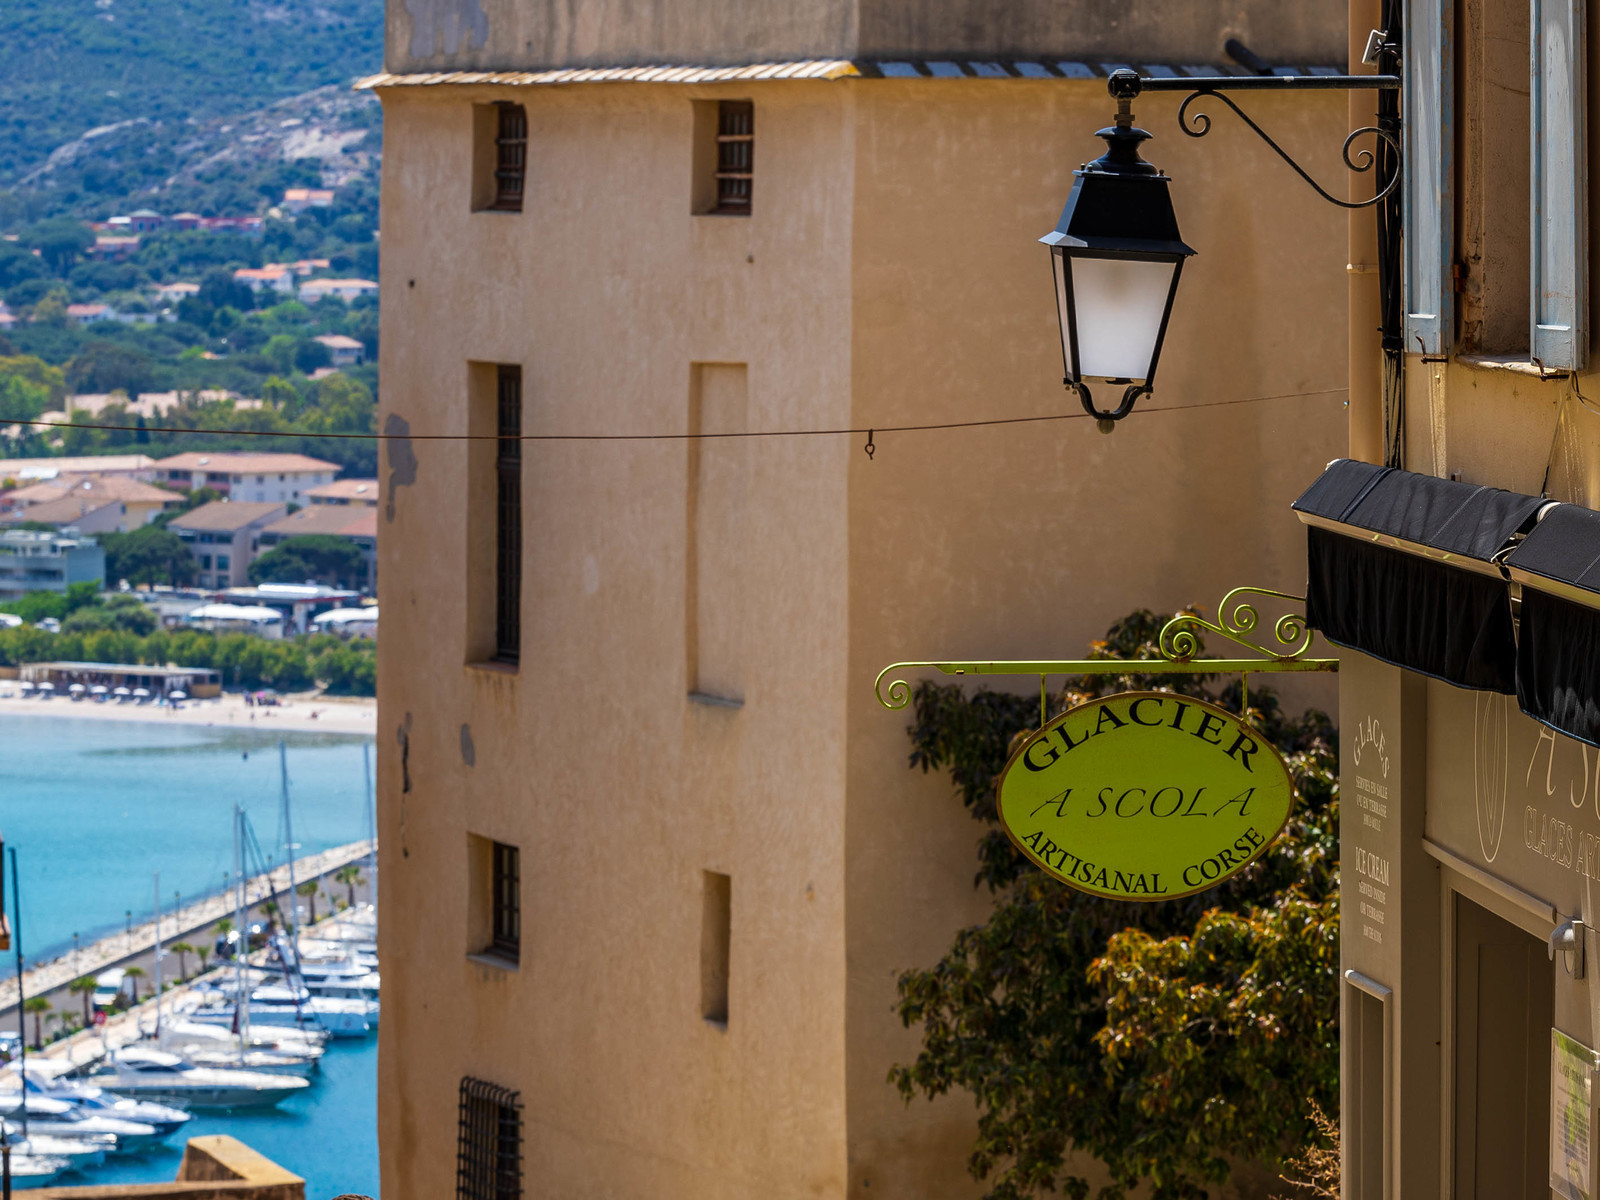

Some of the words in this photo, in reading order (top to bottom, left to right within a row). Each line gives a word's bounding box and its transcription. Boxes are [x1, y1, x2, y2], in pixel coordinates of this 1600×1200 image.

[1023, 698, 1259, 773] GLACIER
[1353, 715, 1390, 779] GLACES
[1030, 788, 1074, 818] A
[1086, 787, 1257, 818] SCOLA
[1022, 831, 1168, 894] ARTISANAL
[1182, 827, 1266, 887] CORSE
[1355, 846, 1366, 875] ICE
[1367, 852, 1389, 887] CREAM
[1523, 805, 1573, 869] GLACES
